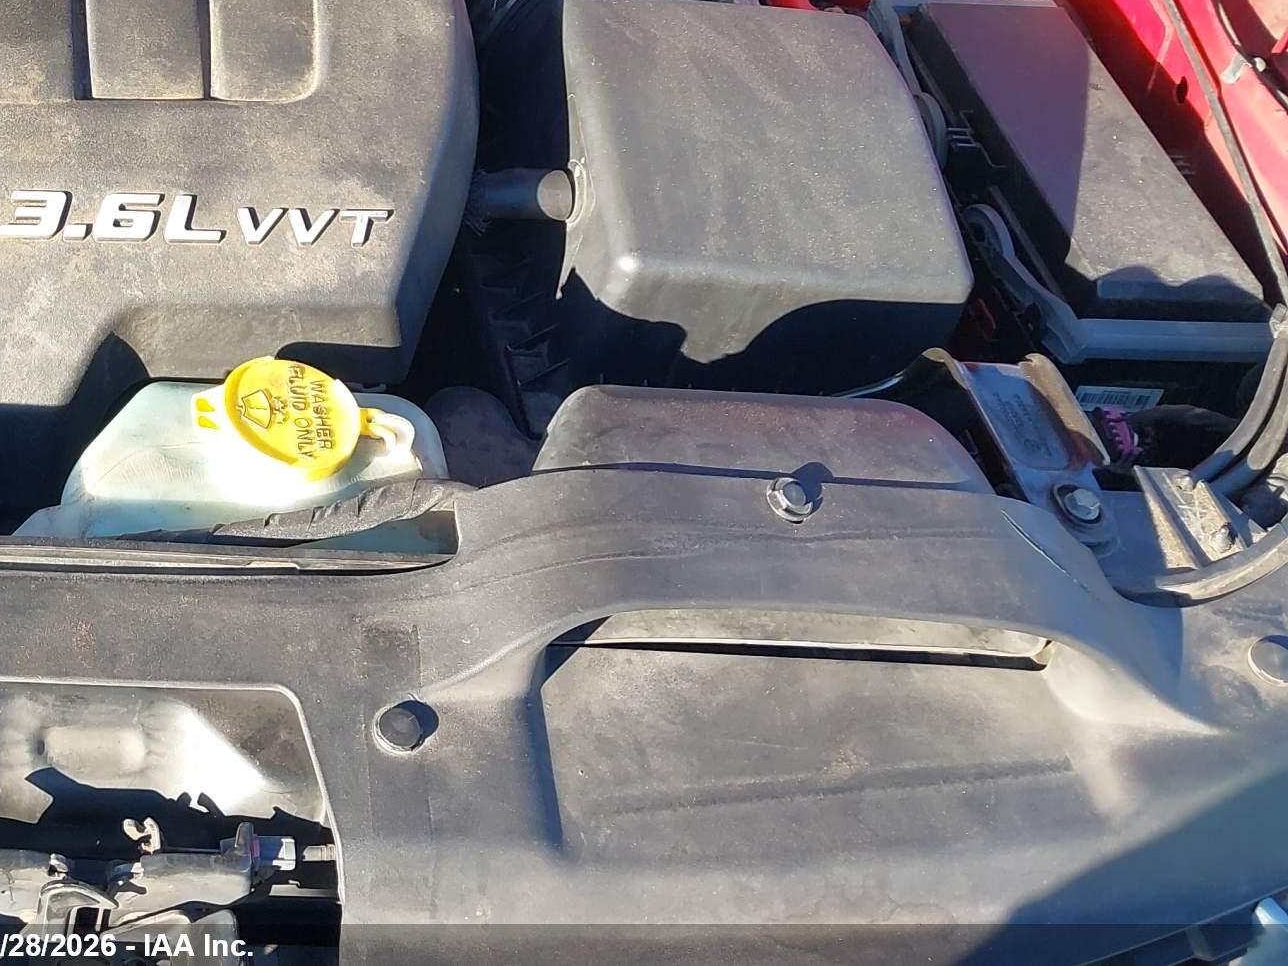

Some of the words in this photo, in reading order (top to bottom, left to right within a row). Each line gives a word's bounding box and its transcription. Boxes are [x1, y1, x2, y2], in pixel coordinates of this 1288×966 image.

[237, 207, 394, 248] VVT
[288, 364, 307, 411] FLUID
[310, 379, 333, 450] WASHER
[293, 416, 314, 459] ONLY
